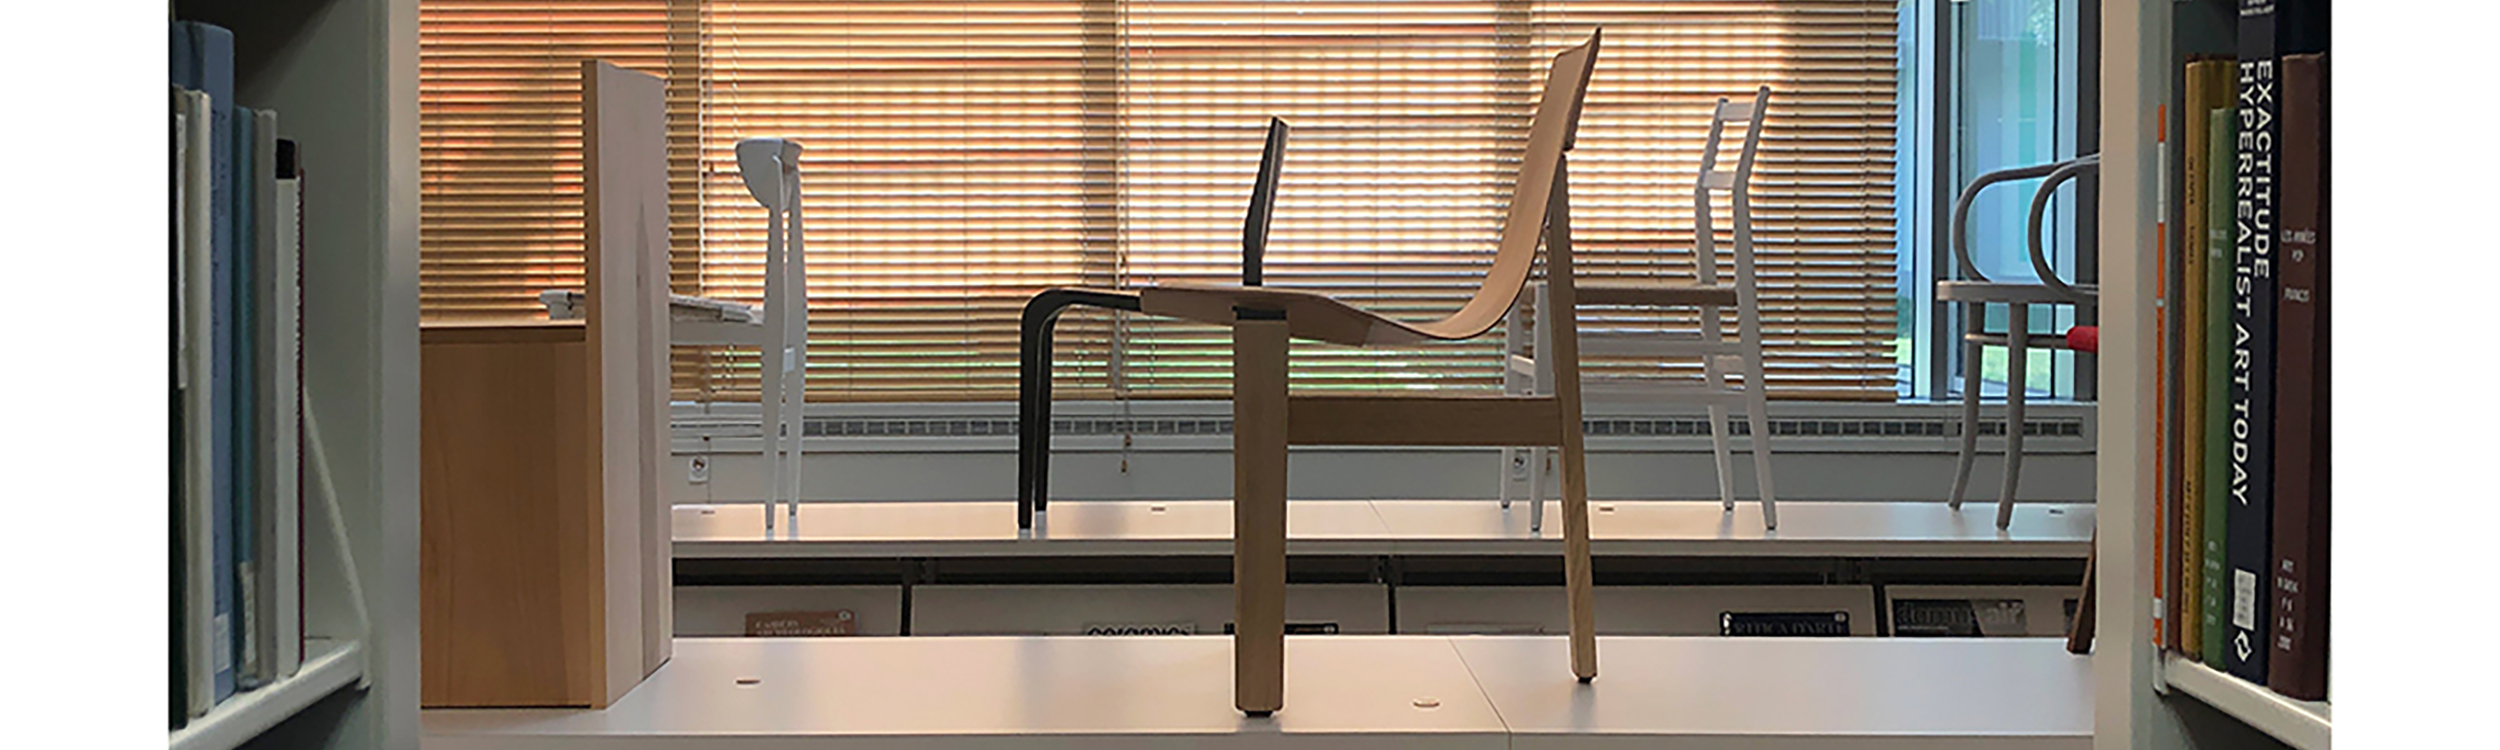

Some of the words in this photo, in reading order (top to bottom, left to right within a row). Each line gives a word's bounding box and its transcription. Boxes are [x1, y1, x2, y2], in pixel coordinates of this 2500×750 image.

[2235, 62, 2255, 318] HYPERREALIST
[2254, 60, 2273, 278] EXACTITUDE
[2233, 323, 2250, 392] ART
[2231, 398, 2249, 506] TODAY
